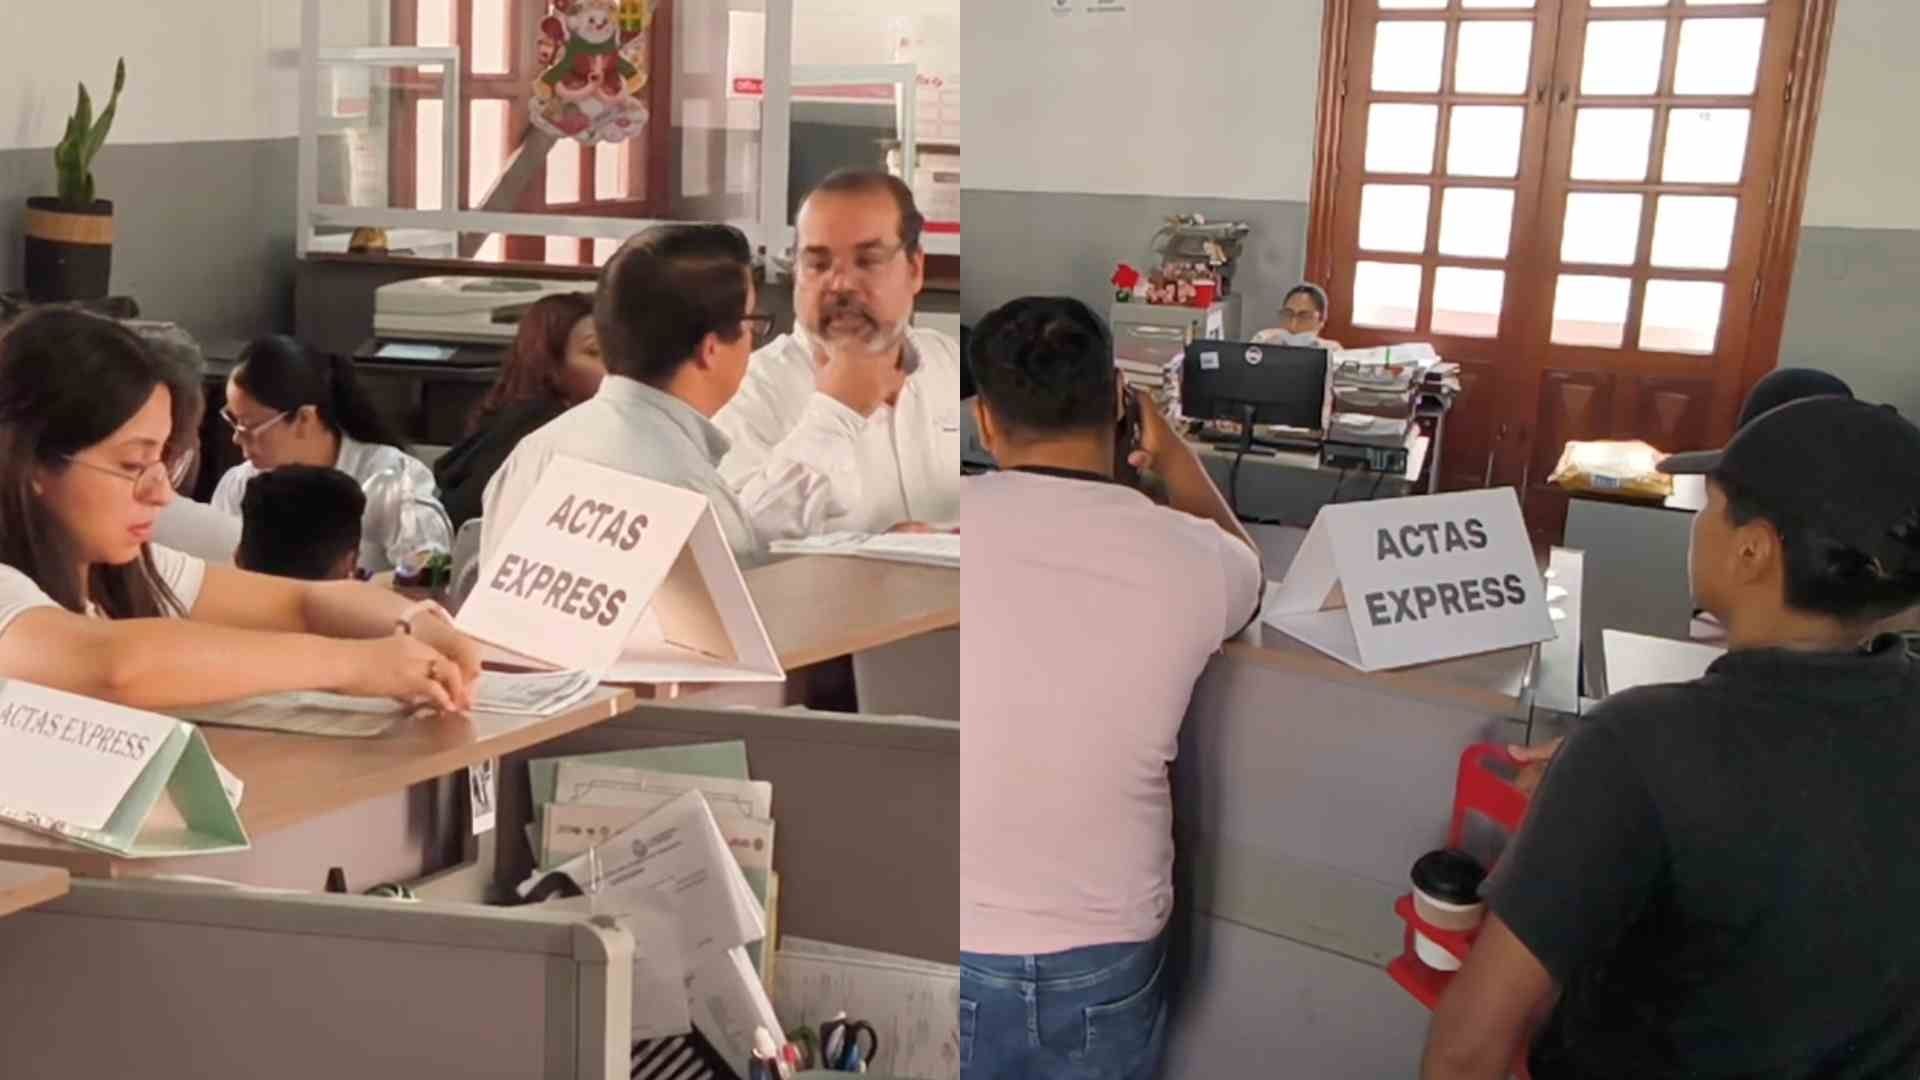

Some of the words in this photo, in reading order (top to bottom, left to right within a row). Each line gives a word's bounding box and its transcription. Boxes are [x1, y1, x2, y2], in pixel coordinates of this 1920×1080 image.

[546, 493, 649, 551] ACTAS
[1377, 517, 1488, 561] ACTAS
[490, 553, 627, 626] EXPRESS
[1365, 573, 1526, 627] EXPRESS
[0, 702, 62, 738] ACTAS
[59, 716, 150, 760] EXPRESS
